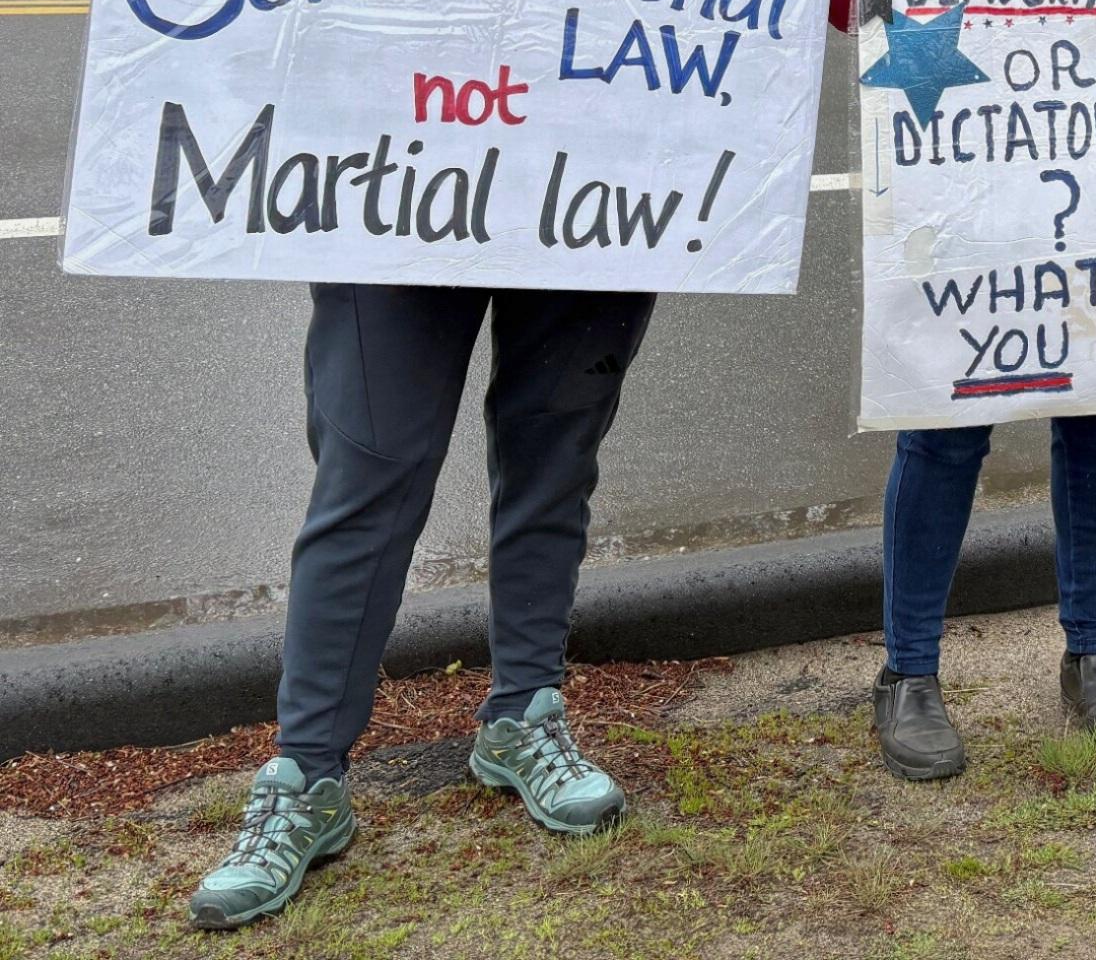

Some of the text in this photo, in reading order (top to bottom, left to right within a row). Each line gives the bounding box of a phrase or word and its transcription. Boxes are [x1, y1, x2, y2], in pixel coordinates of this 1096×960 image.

[560, 8, 742, 107] LAW,
[1004, 40, 1096, 92] OR
[414, 65, 529, 125] not
[148, 101, 736, 253] Martial law!
[1040, 170, 1081, 251] ?
[960, 322, 1068, 377] YOU
